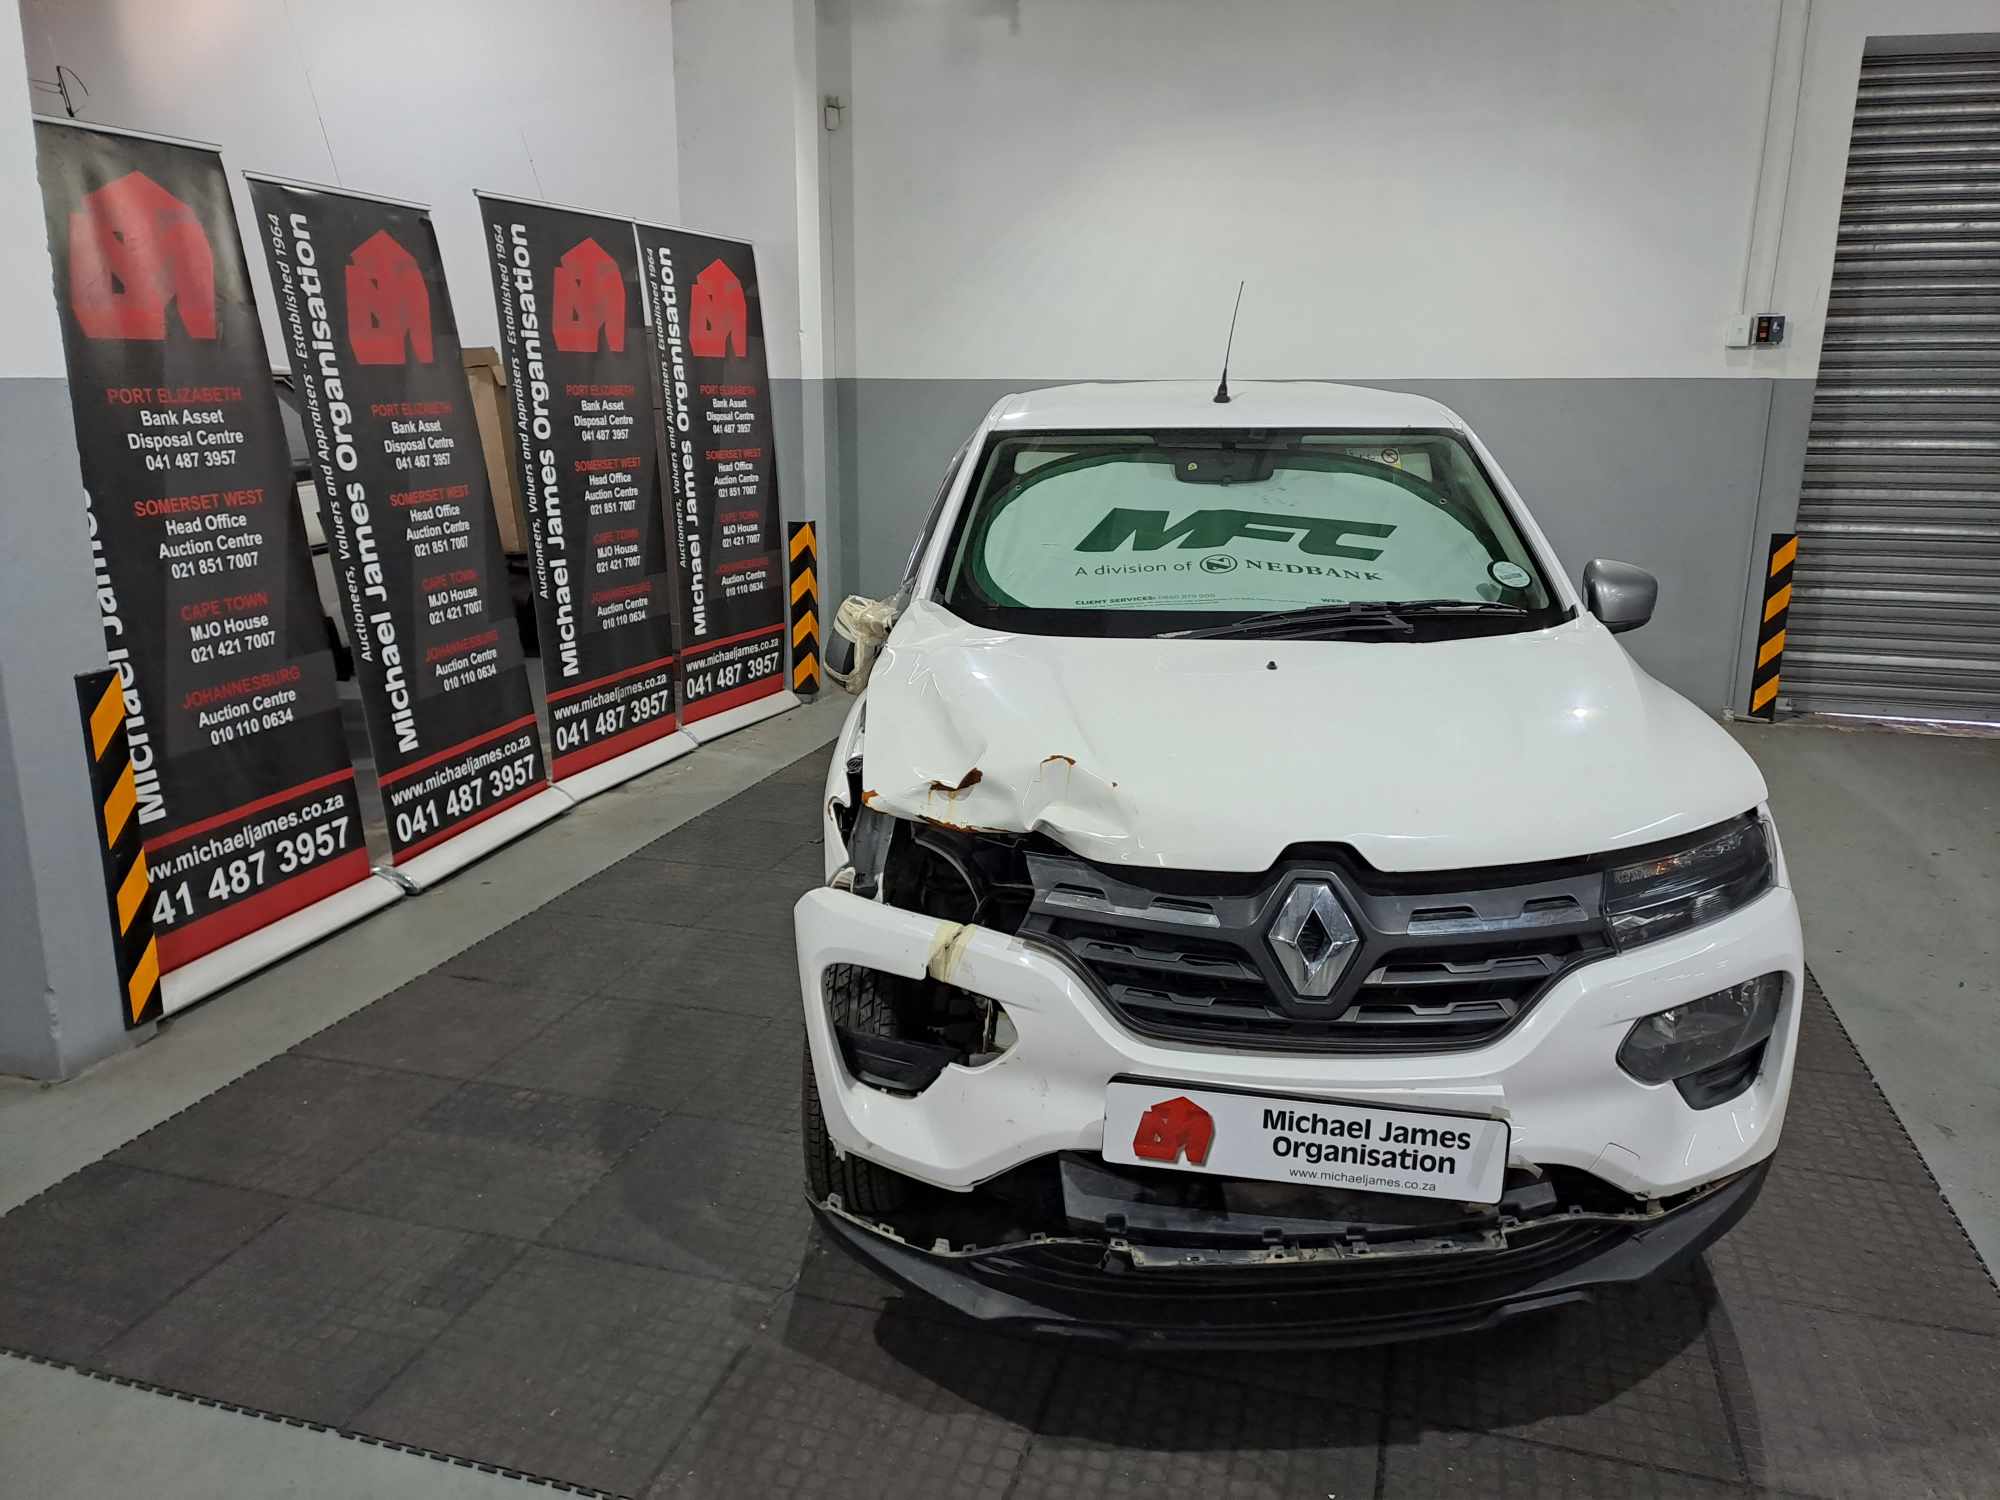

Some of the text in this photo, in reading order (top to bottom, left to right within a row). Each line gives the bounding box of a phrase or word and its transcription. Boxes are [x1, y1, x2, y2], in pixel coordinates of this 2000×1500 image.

[106, 386, 242, 404] PORT ELIZABETH
[140, 409, 224, 426] Bank Asset
[493, 224, 548, 598] Auctioneers, Valuers and Appraisers Established 1964
[127, 430, 243, 451] Disposal Centre
[268, 214, 372, 661] Auctioneers, Valuers and Appraisers Established 1964
[391, 419, 442, 434] Bank Asset
[384, 436, 454, 454] Disposal Centre
[511, 224, 578, 676] Michael James Organisation
[659, 248, 706, 635] Michael James Organisation
[145, 449, 235, 470] 041 487 3957
[395, 452, 450, 470] 041 487 3957
[291, 214, 418, 752] Michael James Organisation
[133, 488, 265, 516] SOMERSET WEST
[409, 504, 460, 522] Head Office
[165, 513, 247, 535] Head Office
[406, 520, 470, 540] Auction Centre
[1073, 507, 1398, 561] MFC
[159, 533, 262, 558] Auction Centre
[414, 535, 468, 557] 021 851 7007
[171, 551, 258, 579] 021 851 7007
[1075, 559, 1382, 580] A division of NEDBANK
[179, 591, 268, 621] CAPE TOWN
[428, 587, 477, 607] MJO House
[429, 599, 482, 624] 021 421 7007
[190, 615, 268, 641] MJO House
[191, 630, 275, 663] 021 421 7007
[686, 638, 778, 671] www.michaeljames.co.za
[435, 649, 497, 676] Auction Centre
[686, 652, 778, 698] 041 487 3957
[181, 665, 300, 709] JOHANNESBURG
[443, 663, 496, 691] 010 110 0634
[199, 690, 296, 727] Auction Centre
[554, 674, 666, 719] www.michaeljames.co.za
[210, 707, 294, 745] 010 110 0634
[556, 689, 667, 750] 041 487 3957
[392, 736, 530, 804] www.michaeljames.co.za
[396, 754, 533, 841] 041 487 3957
[153, 816, 347, 923] 41 487 3957
[1262, 1109, 1471, 1151] Michael James
[1272, 1136, 1456, 1175] Organisation
[1289, 1167, 1436, 1192] www.michaeljames.co.za
